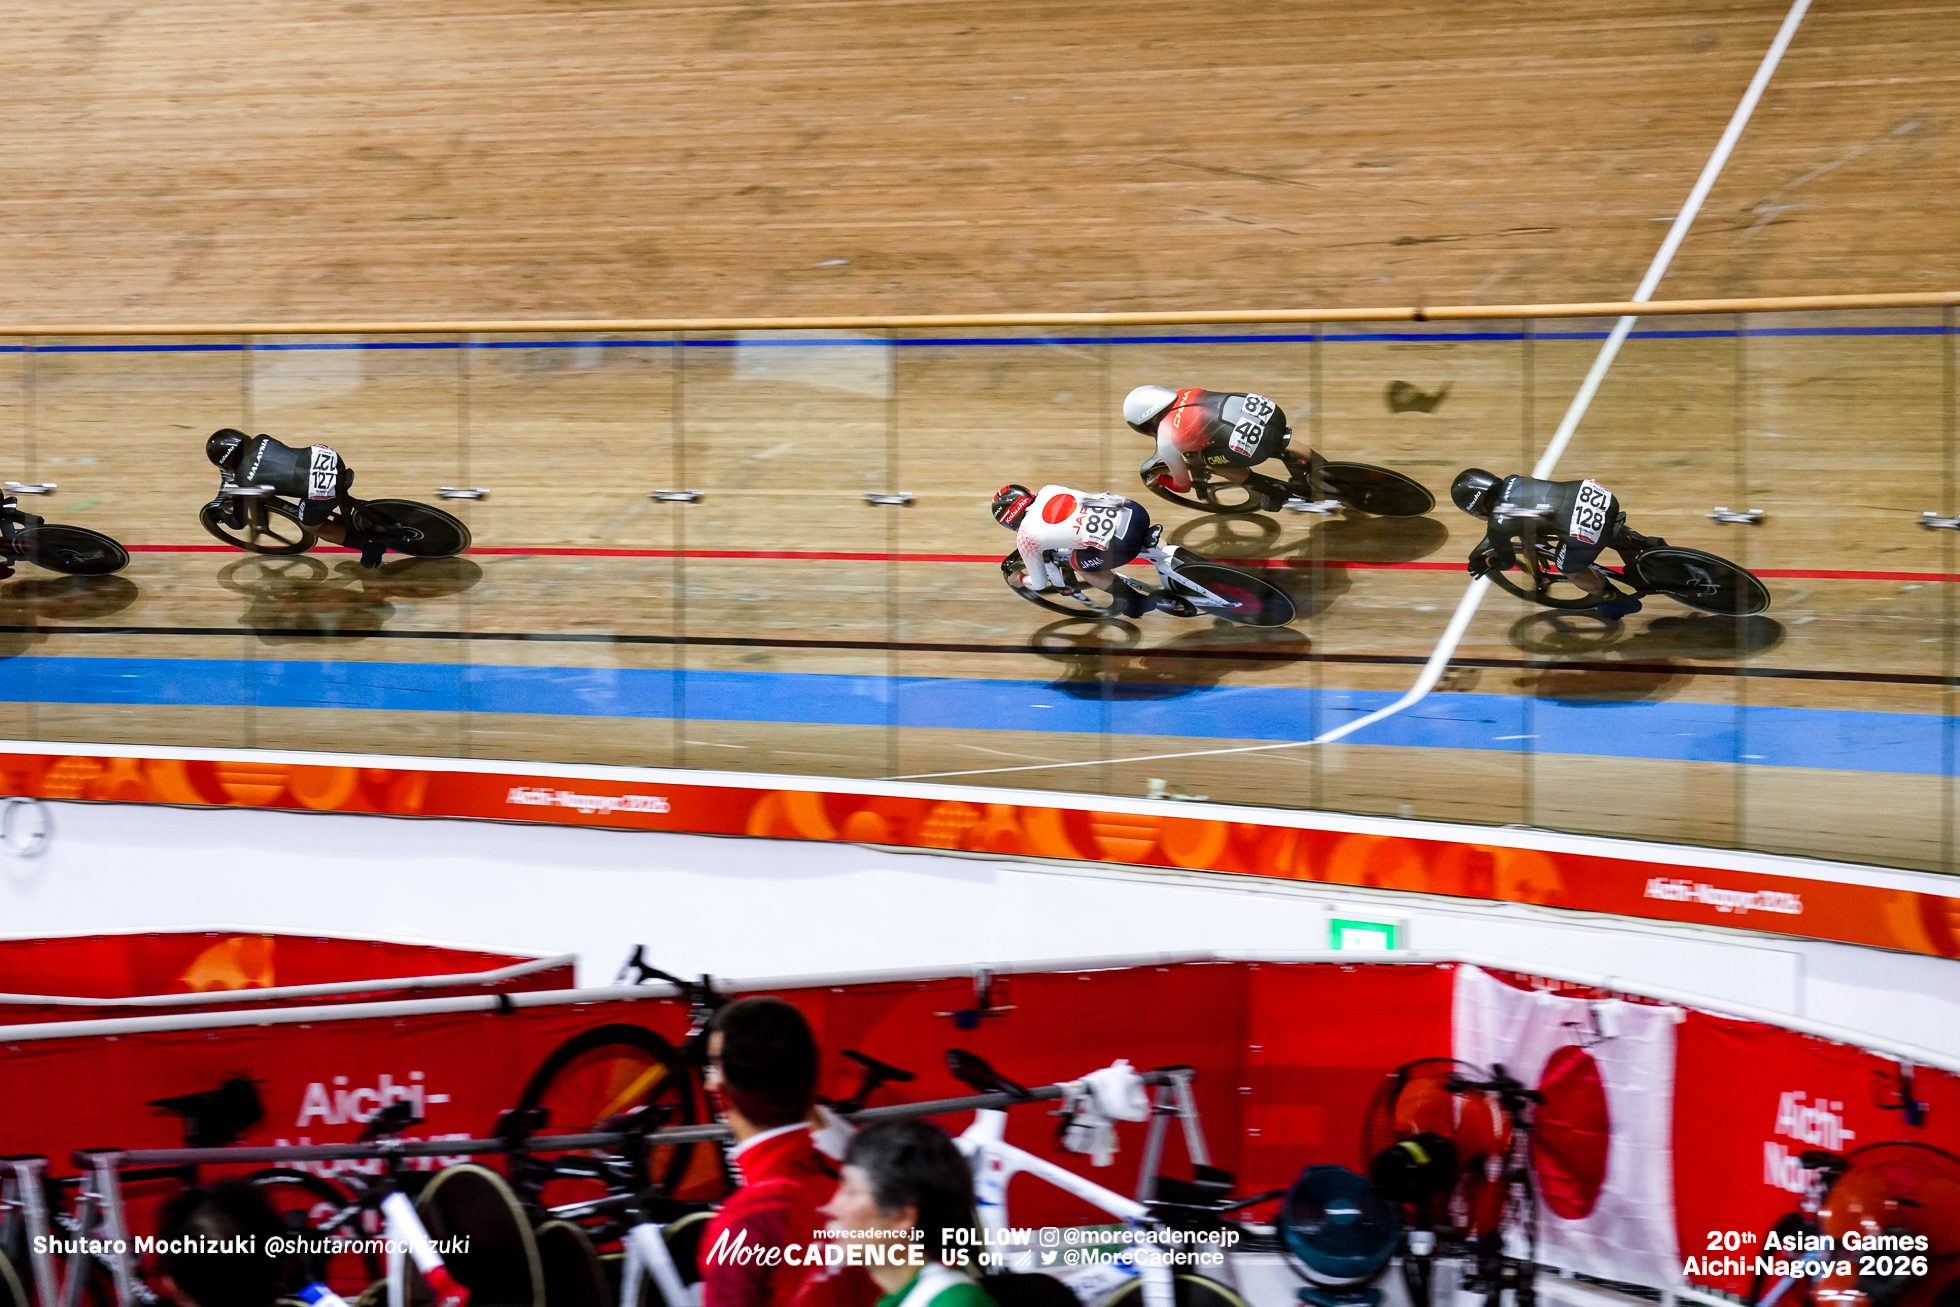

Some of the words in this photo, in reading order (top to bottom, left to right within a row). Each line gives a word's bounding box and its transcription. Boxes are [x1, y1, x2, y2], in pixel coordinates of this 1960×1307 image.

[1173, 390, 1192, 429] CHINA
[1244, 396, 1274, 417] 48
[1235, 421, 1262, 445] 48
[247, 438, 270, 481] MALAYSIA
[313, 453, 336, 472] 127
[1207, 455, 1230, 465] CHINA
[312, 471, 335, 490] 127
[1579, 486, 1607, 510] 128
[1086, 515, 1114, 537] 89
[1575, 505, 1604, 531] 128
[295, 1070, 451, 1128] Aichi-
[1774, 1090, 1856, 1151] Aichi-
